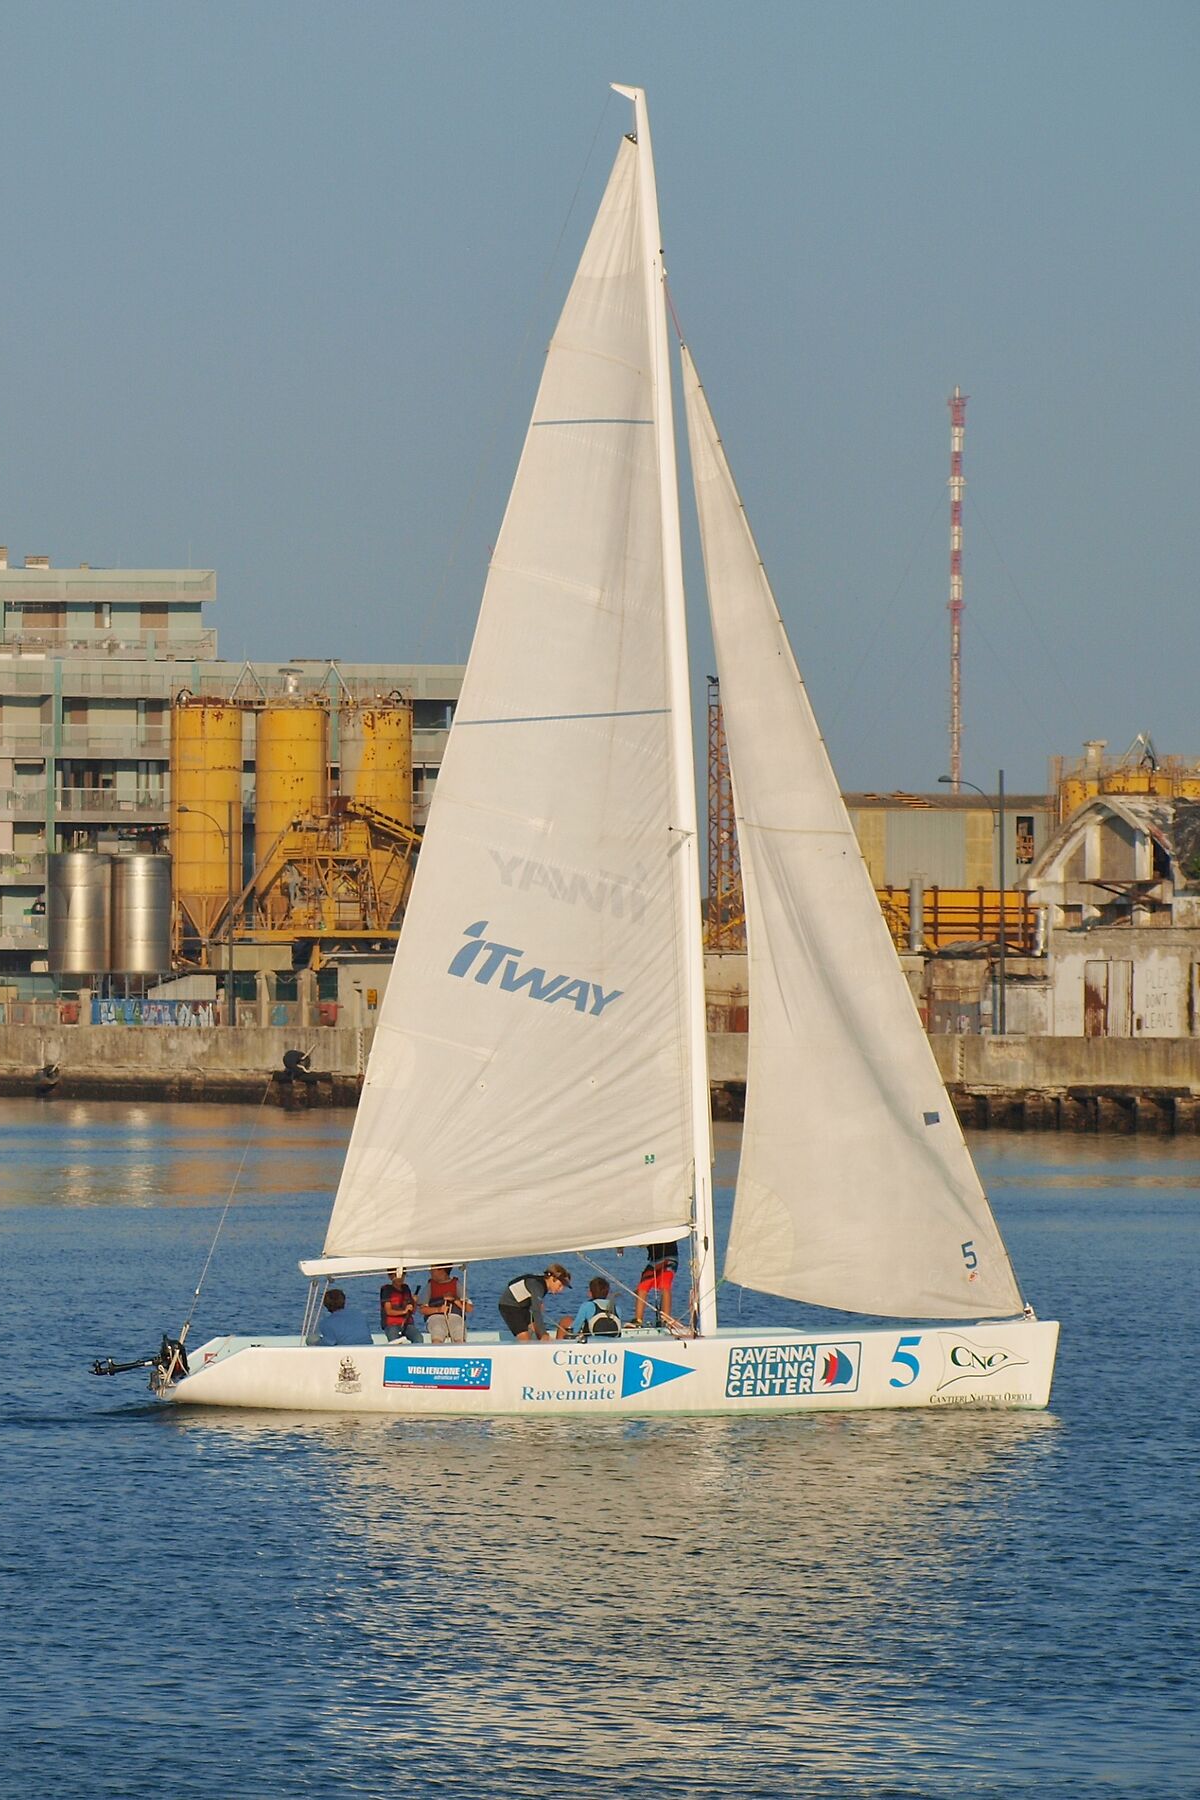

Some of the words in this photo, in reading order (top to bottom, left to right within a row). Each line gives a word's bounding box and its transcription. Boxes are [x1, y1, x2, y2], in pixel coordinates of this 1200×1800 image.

[961, 1241, 977, 1270] 5
[553, 1350, 618, 1366] Circolo
[731, 1345, 815, 1365] RAVENNA
[888, 1336, 923, 1388] 5
[407, 1365, 460, 1375] VIGLIENZONE
[566, 1370, 616, 1384] Velico
[729, 1361, 813, 1380] SAILING
[522, 1386, 615, 1401] Ravennate
[727, 1377, 812, 1396] CENTER
